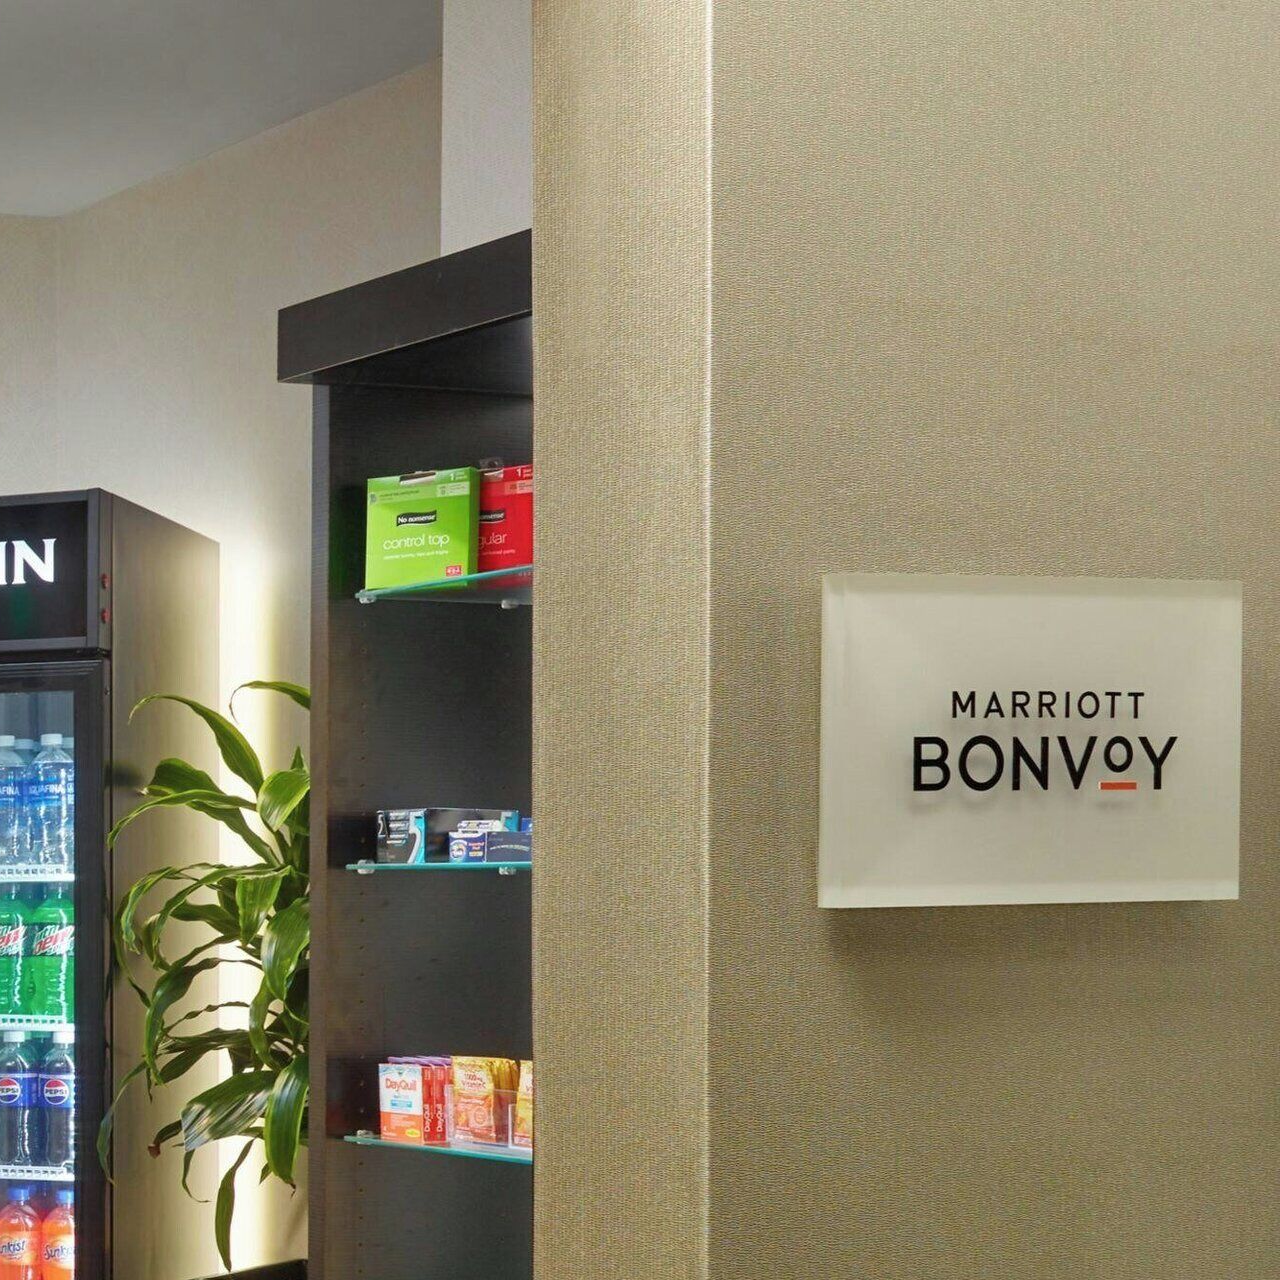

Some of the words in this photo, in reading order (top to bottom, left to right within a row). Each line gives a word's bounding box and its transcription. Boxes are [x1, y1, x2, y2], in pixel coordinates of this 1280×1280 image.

[383, 534, 425, 550] control
[428, 533, 449, 550] top
[478, 532, 507, 549] gular
[951, 690, 1145, 718] MARRIOTT
[912, 735, 1178, 791] BONVOY
[44, 1088, 68, 1096] PEPSI
[385, 1078, 417, 1092] DayQuil
